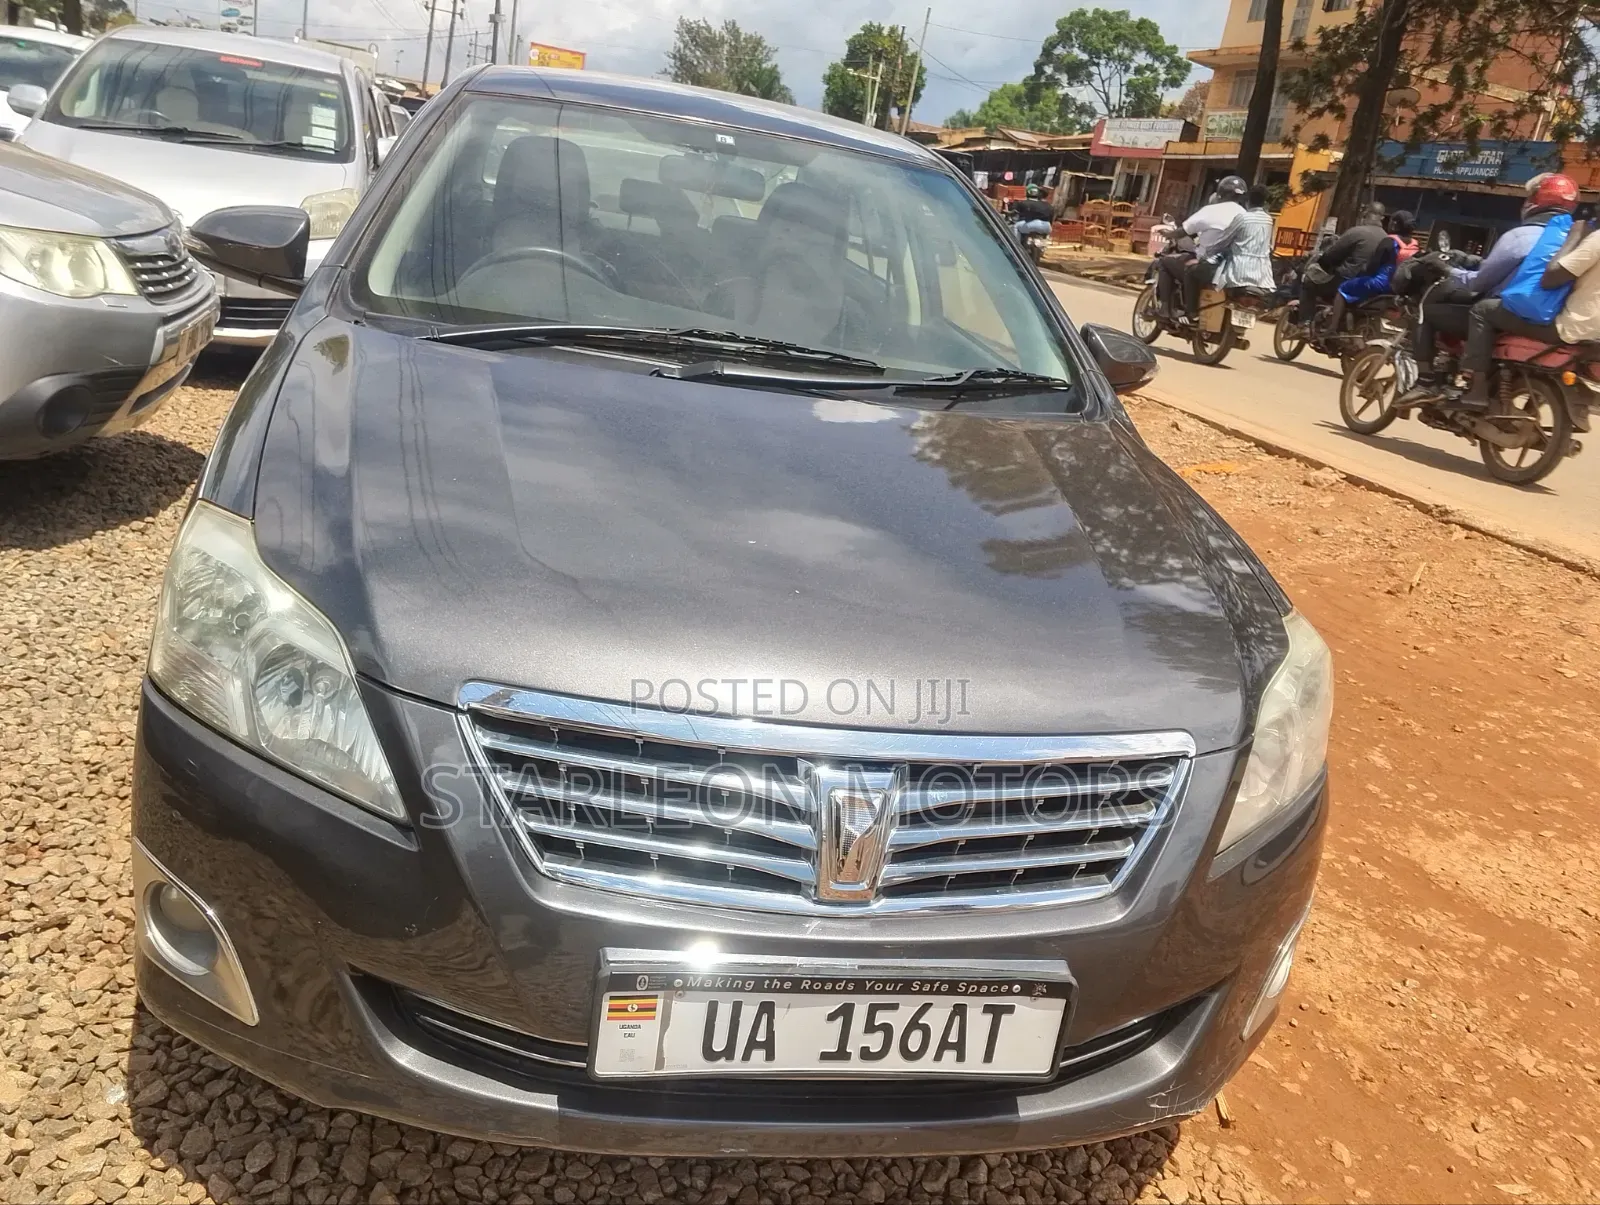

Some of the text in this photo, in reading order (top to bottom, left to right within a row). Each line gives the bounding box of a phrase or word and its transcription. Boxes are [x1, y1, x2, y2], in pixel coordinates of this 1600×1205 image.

[687, 976, 1009, 995] Making the Roads Your Safe Space
[702, 1000, 1016, 1064] UA 156AT
